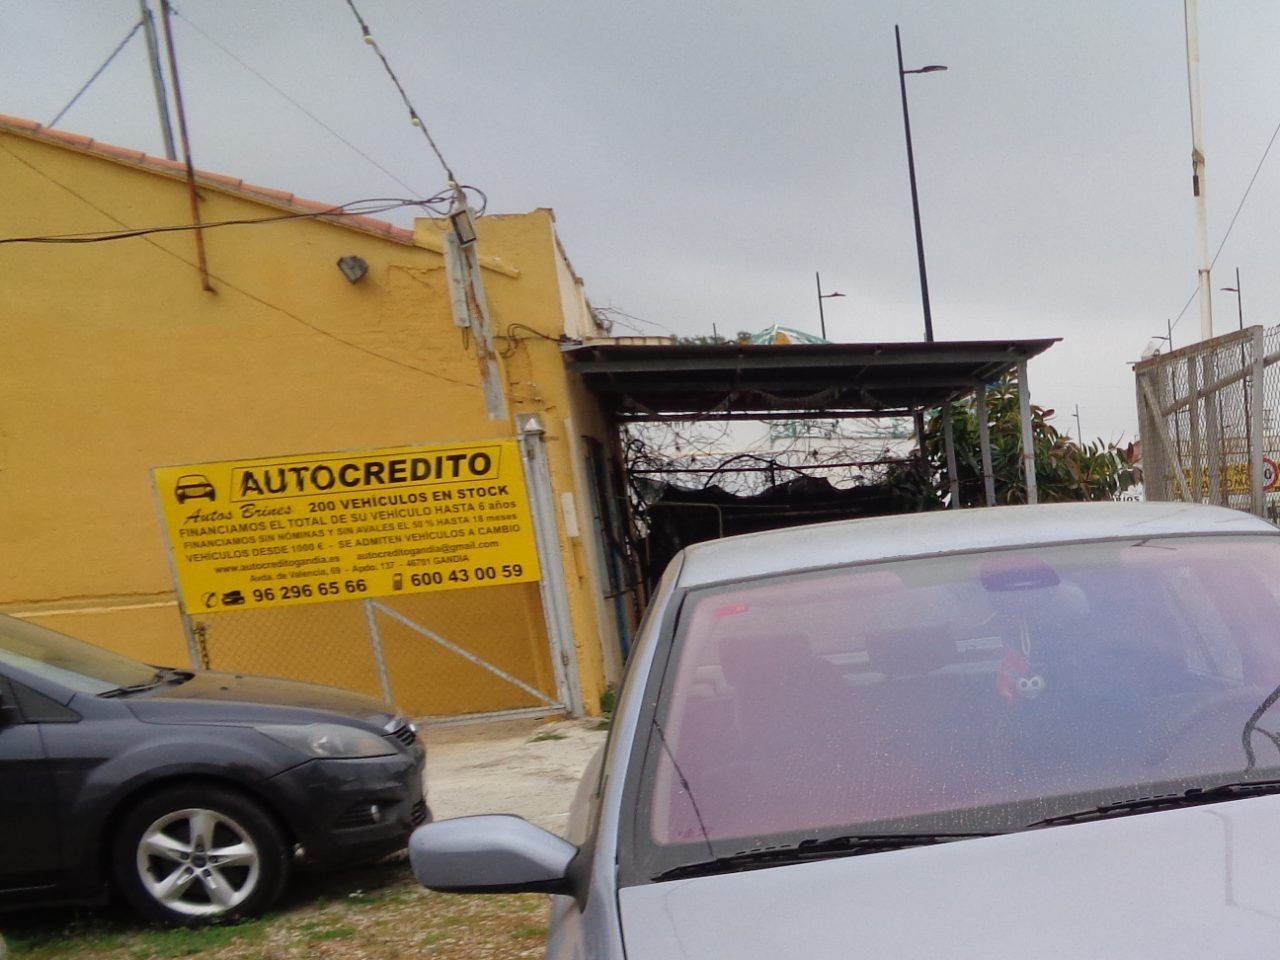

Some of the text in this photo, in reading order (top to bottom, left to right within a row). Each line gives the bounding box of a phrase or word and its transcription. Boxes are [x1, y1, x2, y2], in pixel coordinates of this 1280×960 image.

[241, 452, 491, 495] AUTOCREDITO
[307, 484, 508, 513] 200 VEHÍCULOS EN STOCK
[178, 499, 517, 537] FINANCIAMOS EL TOTAL DE SU VEHÍCULO HASTA 6 años
[183, 535, 256, 549] FINANCIAMOS
[257, 534, 275, 543] SIN
[336, 526, 354, 536] SIN
[355, 522, 395, 534] AVALES
[396, 521, 410, 530] EL
[436, 516, 470, 526] HASTA
[185, 548, 249, 562] VEHÍCULOS
[251, 545, 289, 556] DESDE
[337, 538, 355, 548] SE
[354, 534, 402, 546] ADMITEN
[403, 528, 465, 542] VEHÍCULOS
[467, 528, 476, 536] A
[477, 523, 520, 535] CAMBIO
[252, 578, 367, 602] 96 296 65 66
[410, 563, 523, 587] 600 43 00 59
